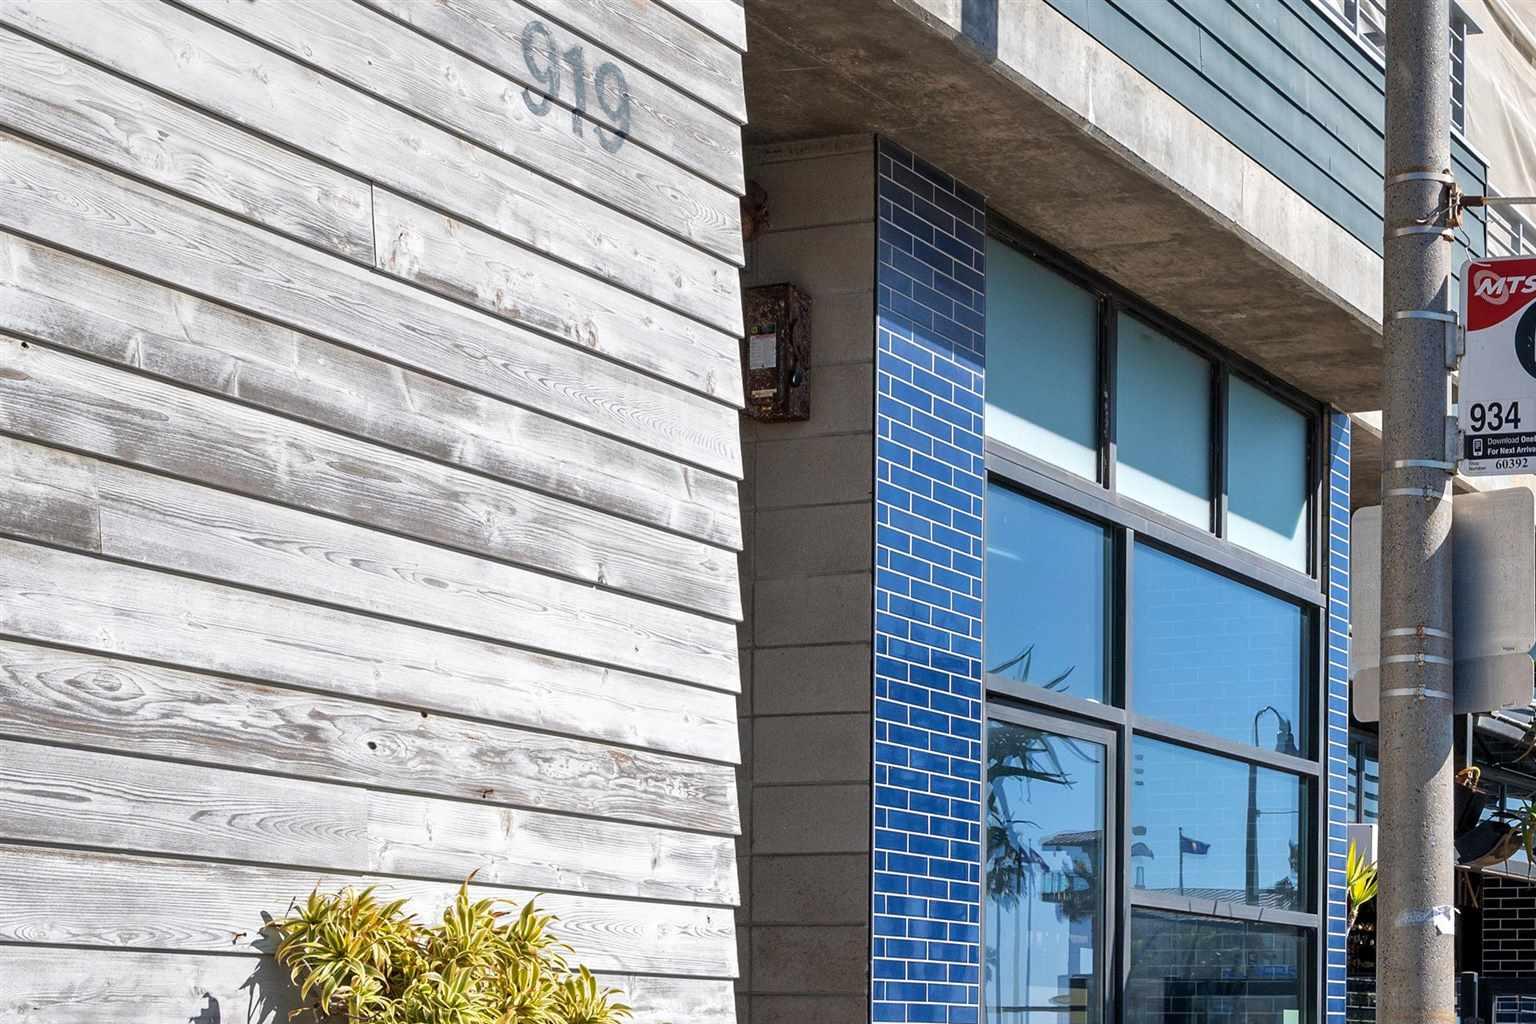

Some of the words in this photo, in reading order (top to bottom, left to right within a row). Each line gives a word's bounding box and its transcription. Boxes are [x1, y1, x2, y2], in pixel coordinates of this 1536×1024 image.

[520, 20, 631, 154] 919
[1470, 401, 1521, 432] 934
[1487, 436, 1520, 445] Download
[1488, 447, 1499, 455] For
[1500, 446, 1515, 454] Next
[1495, 458, 1529, 470] 60392
